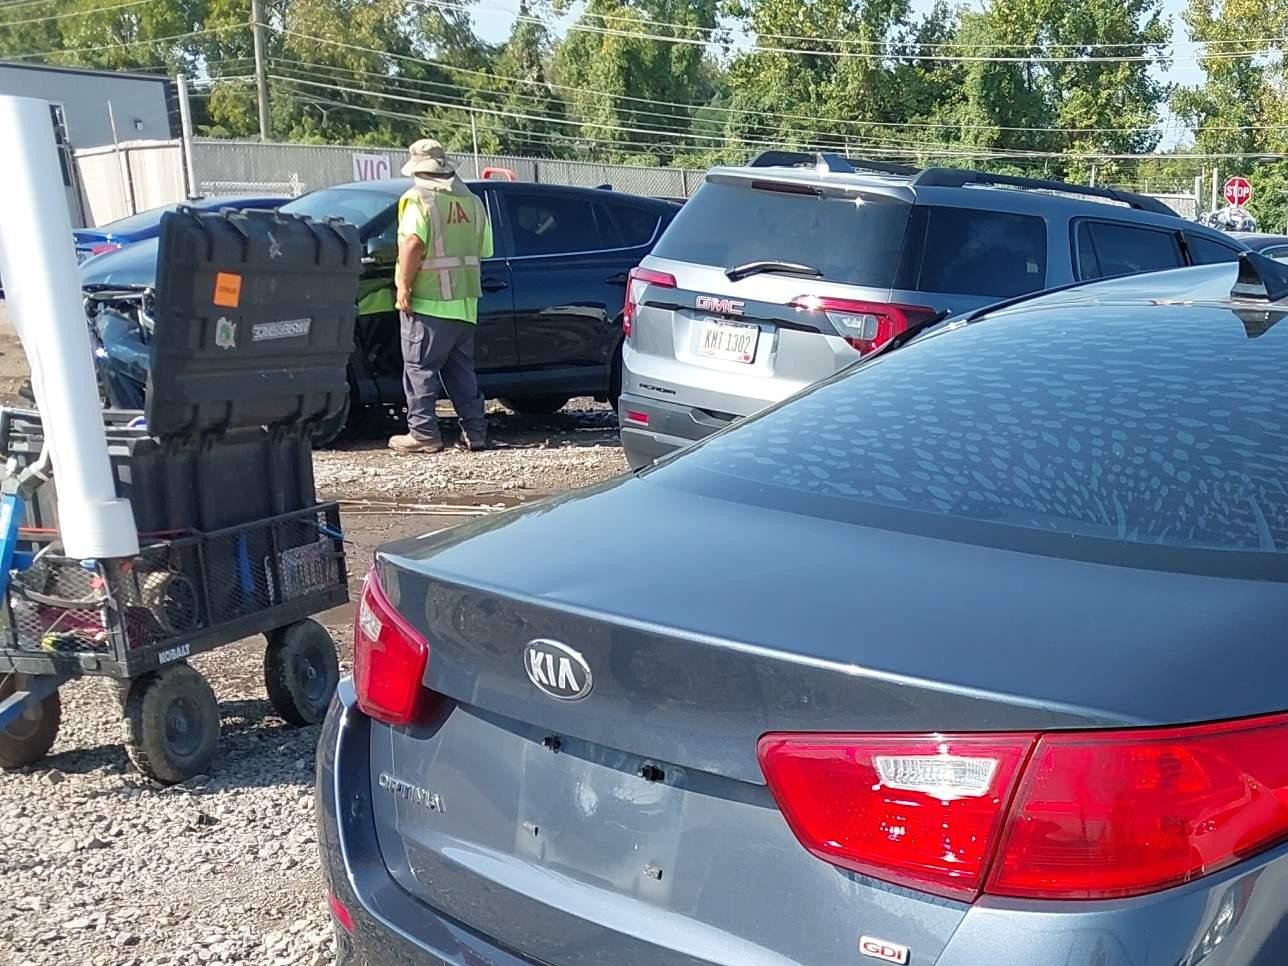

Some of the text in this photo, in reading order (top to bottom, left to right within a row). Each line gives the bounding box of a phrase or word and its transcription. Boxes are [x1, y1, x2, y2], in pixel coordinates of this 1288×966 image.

[1226, 185, 1250, 198] STOP
[695, 295, 746, 316] GMC
[725, 332, 752, 354] 1302
[158, 643, 191, 665] KOBALT
[529, 648, 580, 692] KIA
